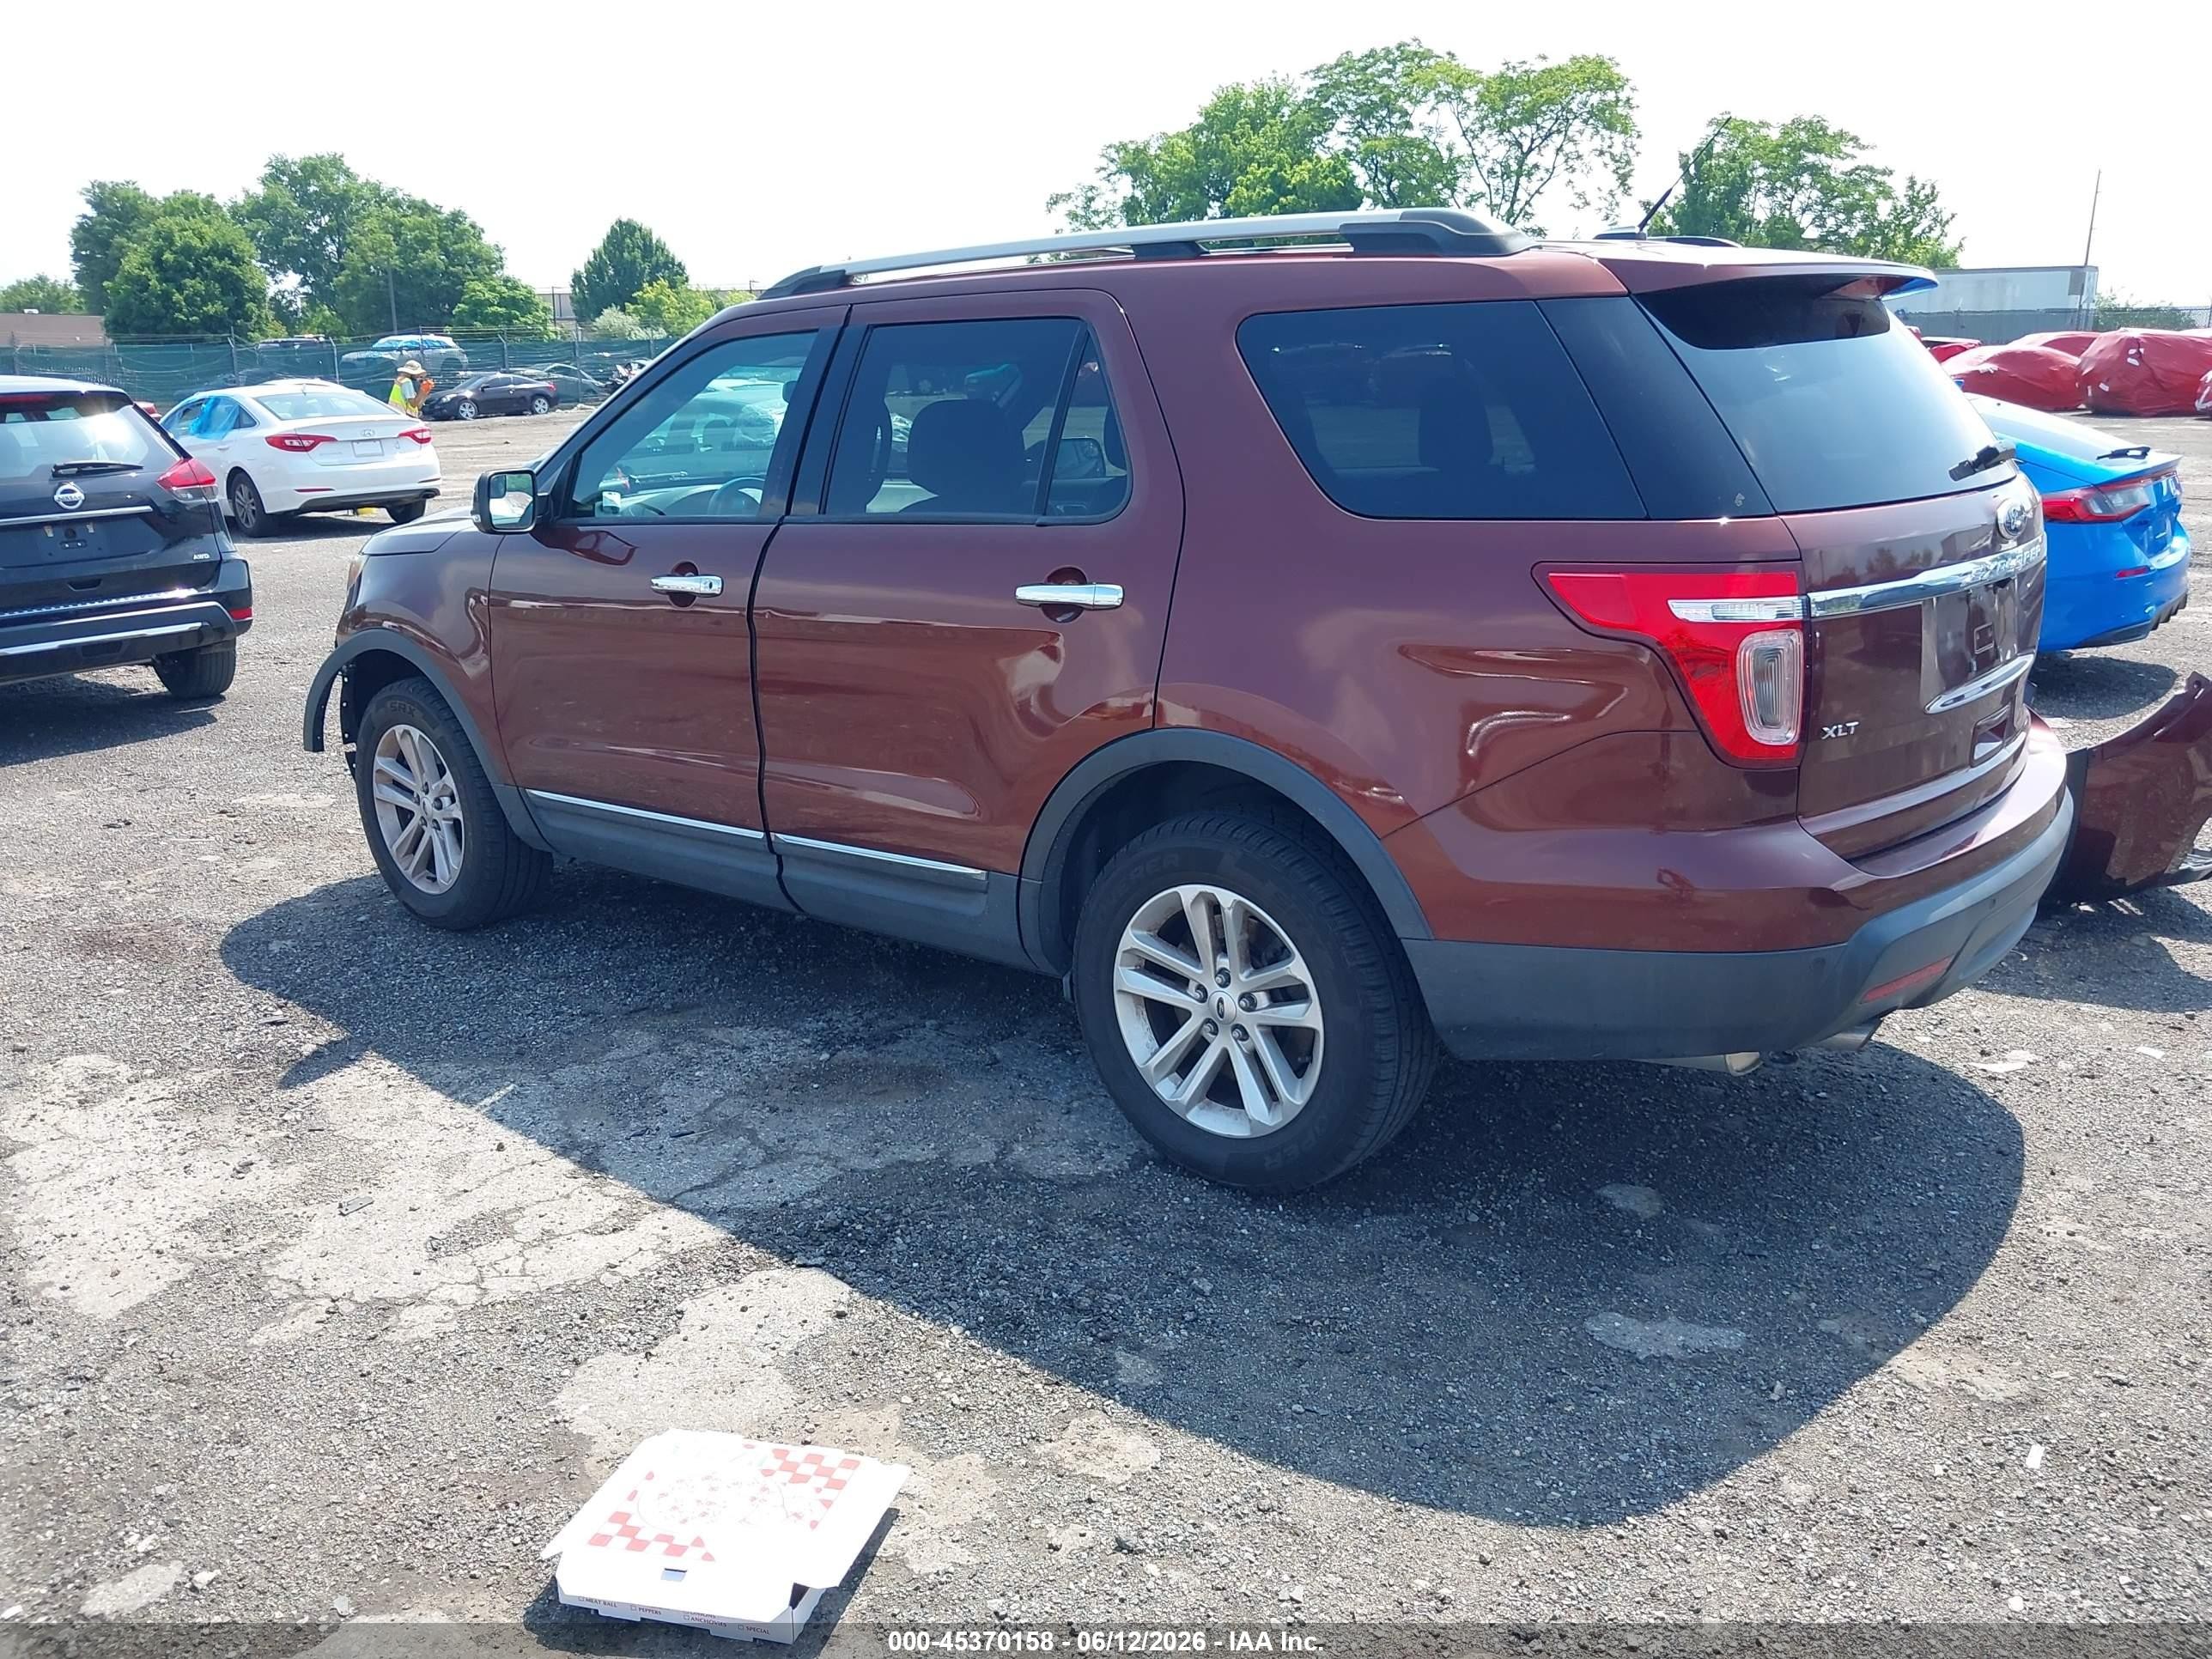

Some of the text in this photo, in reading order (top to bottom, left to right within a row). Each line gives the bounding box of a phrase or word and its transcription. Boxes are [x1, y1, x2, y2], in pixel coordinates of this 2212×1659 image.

[389, 702, 416, 717] SRX
[1821, 721, 1859, 739] XLT
[638, 1607, 662, 1615] PEPPERS
[690, 1616, 727, 1627] ANCHOVIES
[746, 1626, 770, 1635] SPECIAL
